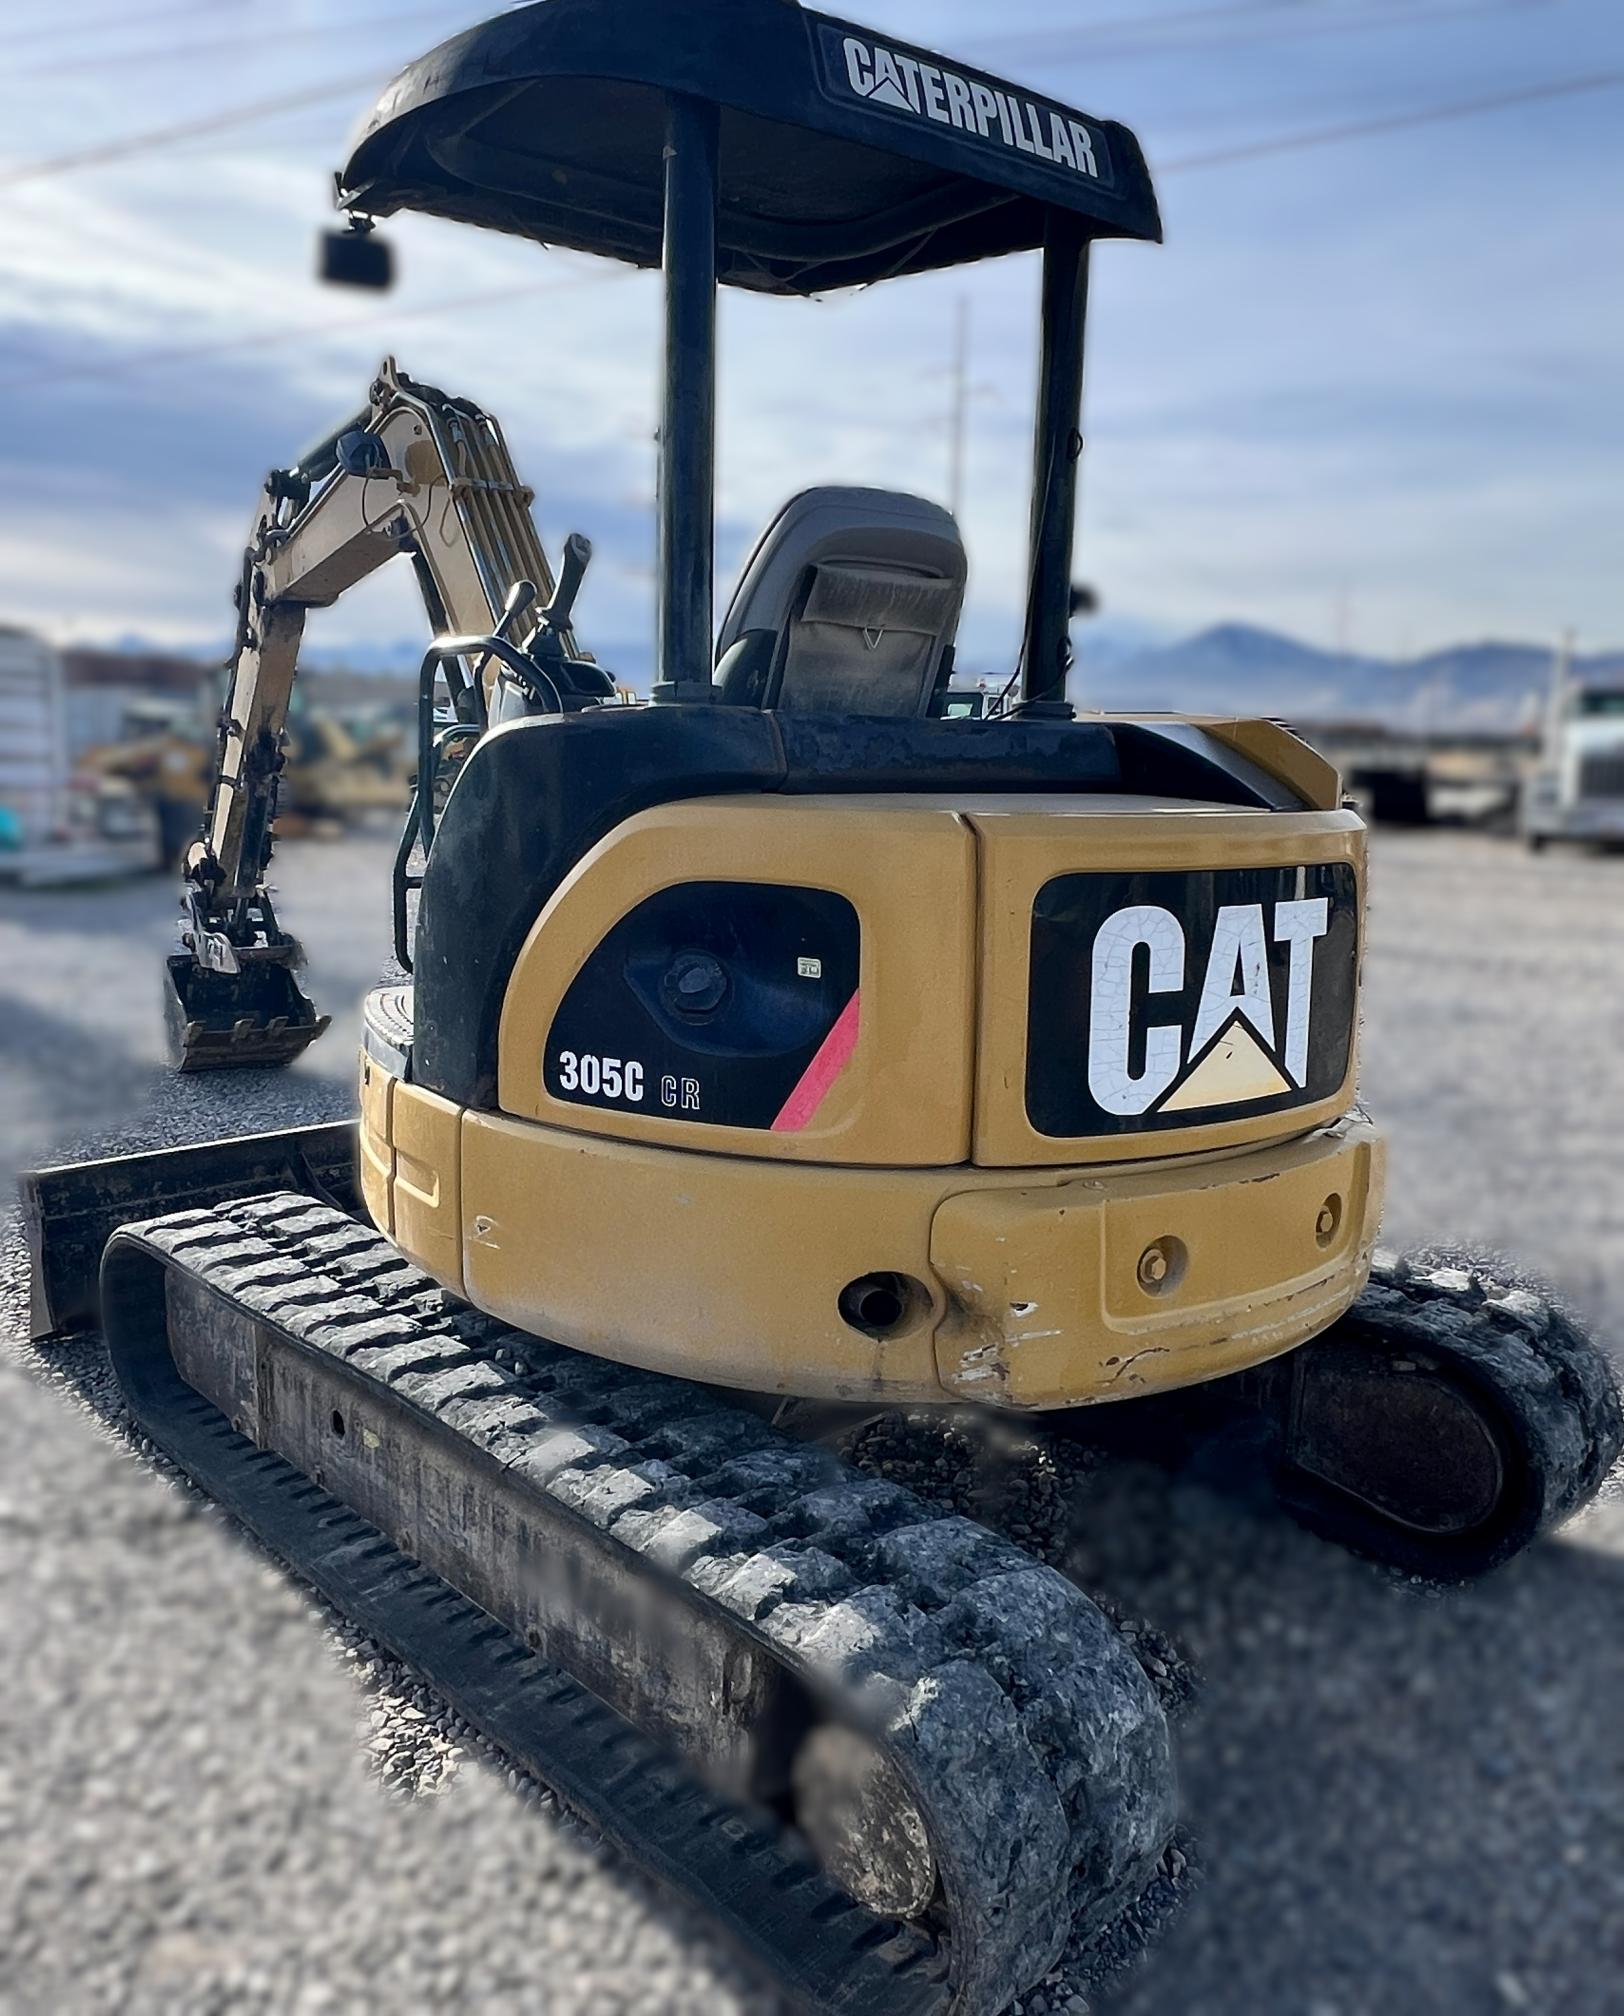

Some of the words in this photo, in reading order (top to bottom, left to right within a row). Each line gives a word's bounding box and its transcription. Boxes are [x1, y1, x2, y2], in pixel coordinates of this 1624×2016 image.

[843, 37, 1099, 178] CATERPILLAR
[1088, 897, 1329, 1116] CAT
[559, 1050, 644, 1102] 305C
[660, 1075, 700, 1110] CR
